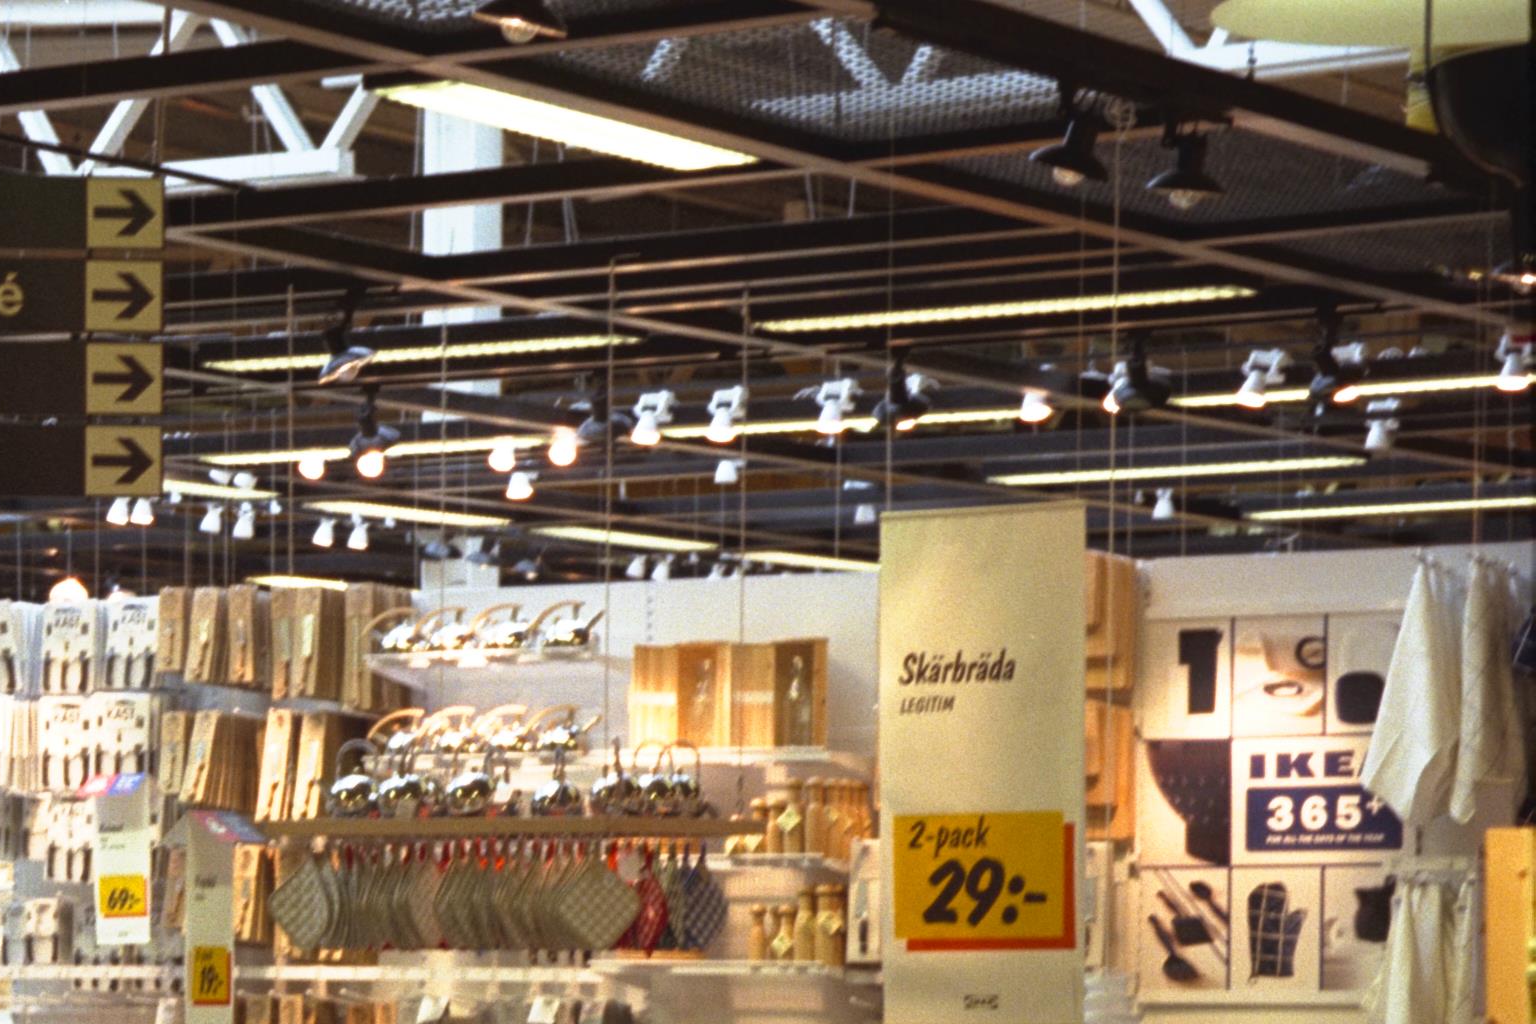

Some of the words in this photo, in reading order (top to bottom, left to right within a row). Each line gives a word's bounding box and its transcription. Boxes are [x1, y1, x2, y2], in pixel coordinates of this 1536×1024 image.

[898, 648, 1016, 686] Skärbräda
[900, 695, 956, 715] LEGITIM
[1250, 750, 1366, 779] IKE
[1266, 794, 1385, 832] 365+
[909, 814, 990, 859] 2-pack
[922, 857, 1048, 928] 29:-
